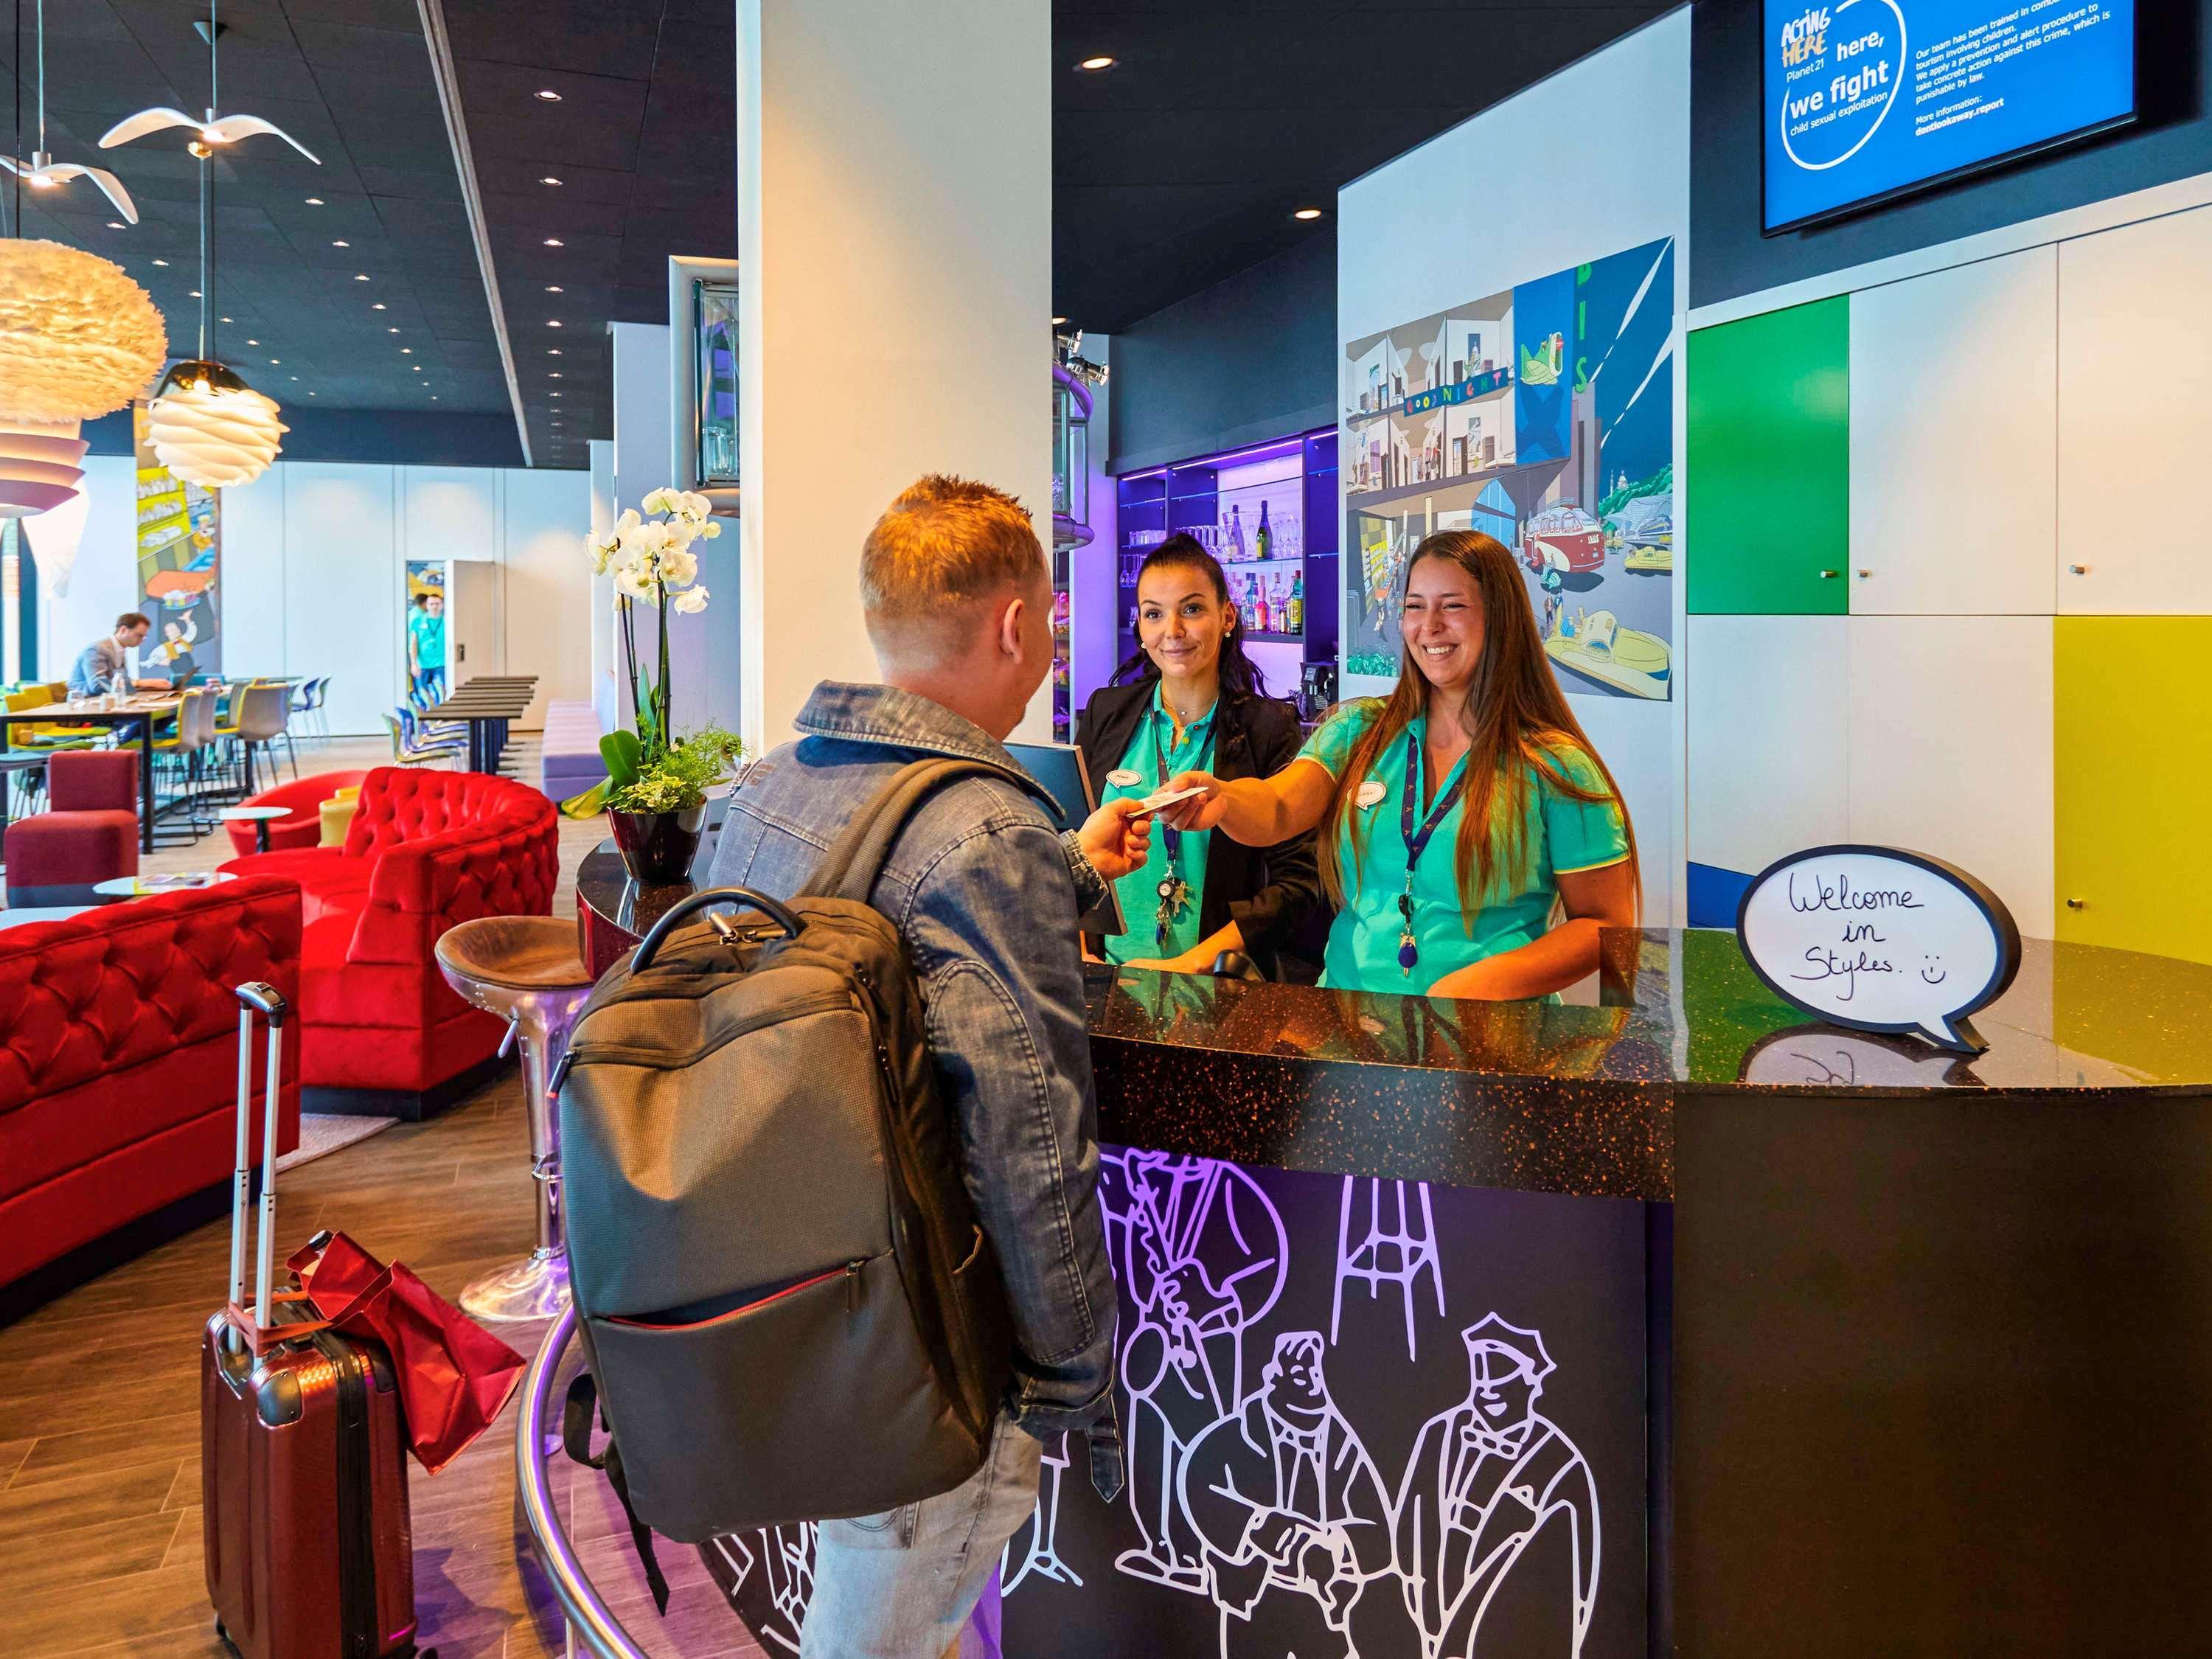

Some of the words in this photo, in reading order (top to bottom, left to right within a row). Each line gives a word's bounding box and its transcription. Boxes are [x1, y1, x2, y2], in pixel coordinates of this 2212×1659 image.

[1781, 29, 1828, 68] HERE
[1836, 31, 1885, 62] here,
[1916, 49, 1930, 59] Our
[1932, 40, 1951, 53] team
[1952, 33, 1967, 44] has
[1968, 24, 1988, 38] been
[1989, 10, 2019, 29] trained
[2020, 7, 2029, 16] in
[1916, 72, 1928, 81] We
[1930, 63, 1950, 77] apply
[1951, 60, 1957, 68] a
[1958, 43, 2000, 66] prevention
[2002, 34, 2018, 47] and
[2020, 26, 2039, 41] alert
[2041, 8, 2086, 34] procedure
[2087, 3, 2098, 13] to
[1916, 54, 1944, 71] tourism
[1946, 38, 1980, 59] involving
[1981, 25, 2017, 44] children.
[1916, 80, 1933, 93] take
[1933, 67, 1966, 86] concrete
[1967, 58, 1992, 72] action
[1993, 44, 2024, 63] against
[2025, 38, 2042, 50] this
[2043, 27, 2071, 43] crime,
[2073, 14, 2100, 31] which
[2102, 10, 2111, 20] is
[1787, 63, 1815, 83] Planet
[1815, 58, 1825, 71] 21
[1790, 91, 1823, 119] we
[1830, 60, 1889, 103] fight
[1916, 83, 1956, 105] punishable
[1957, 78, 1968, 88] by
[1969, 72, 1985, 83] law.
[1790, 121, 1809, 136] child
[1810, 110, 1837, 128] sexual
[1837, 91, 1888, 117] exploitation
[1916, 113, 1934, 125] More
[1935, 95, 1983, 118] information:
[1916, 97, 2005, 136] dontlookaway.report
[1790, 872, 1924, 913] Welcome
[1841, 921, 1886, 943] in
[1790, 946, 1903, 1001] Styles.
